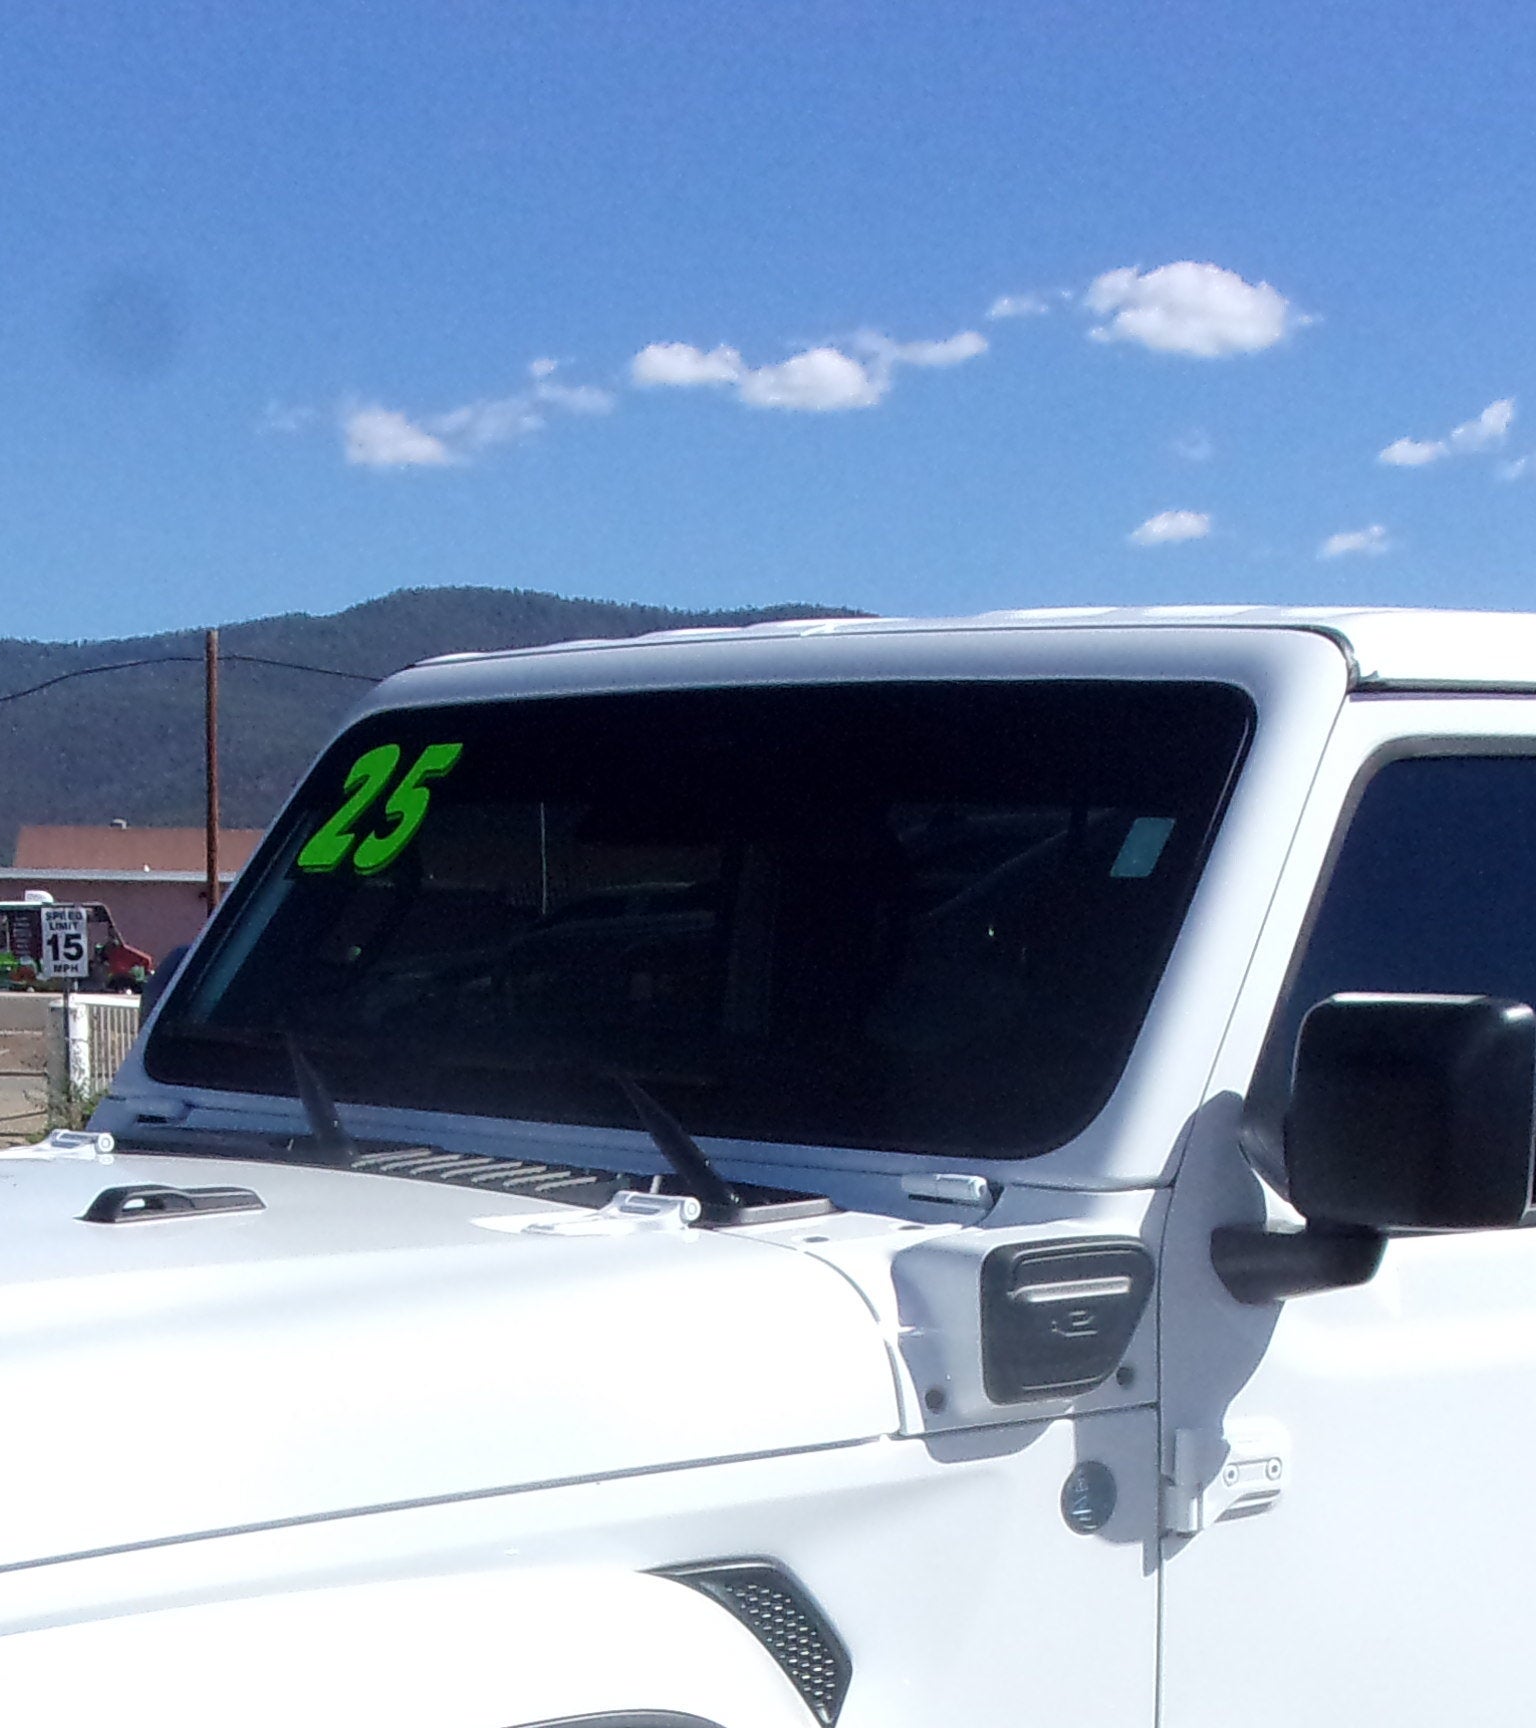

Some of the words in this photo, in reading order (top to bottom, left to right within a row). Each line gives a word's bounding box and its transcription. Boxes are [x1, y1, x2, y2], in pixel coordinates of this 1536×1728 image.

[297, 743, 462, 875] 25
[45, 911, 83, 920] SPEED
[49, 922, 78, 931] LIMIT
[47, 933, 83, 961] 15
[53, 964, 79, 973] MPH
